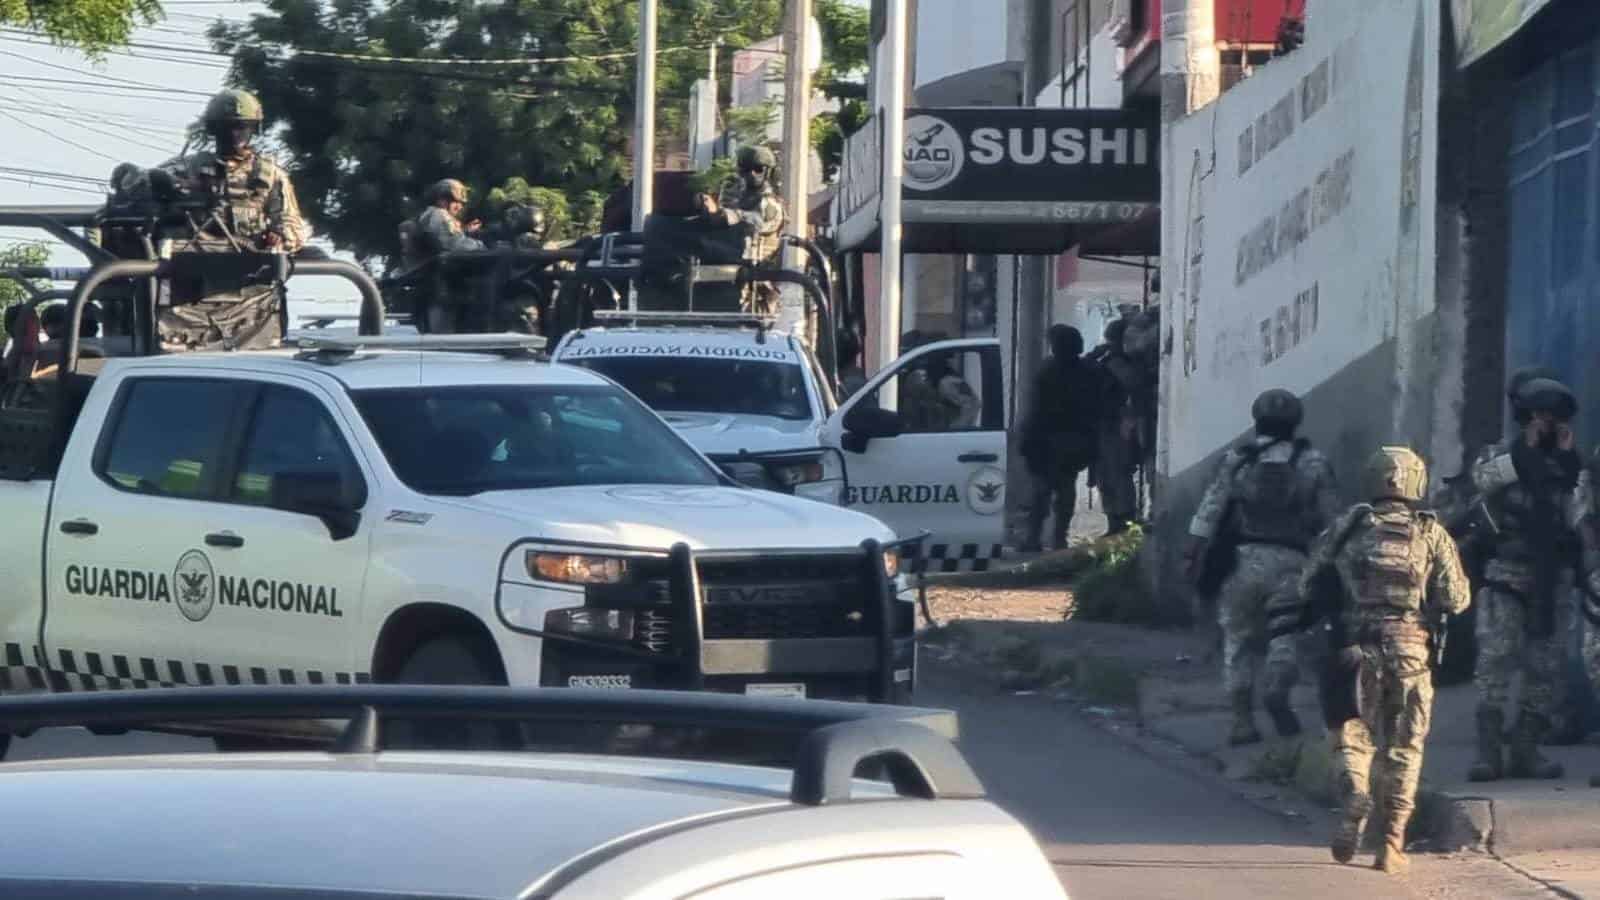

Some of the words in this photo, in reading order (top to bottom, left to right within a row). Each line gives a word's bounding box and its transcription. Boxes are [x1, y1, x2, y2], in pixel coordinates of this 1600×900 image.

[968, 127, 1148, 165] SUSHI
[845, 484, 960, 504] GUARDIA
[65, 564, 171, 603] GUARDIA
[218, 575, 343, 617] NACIONAL
